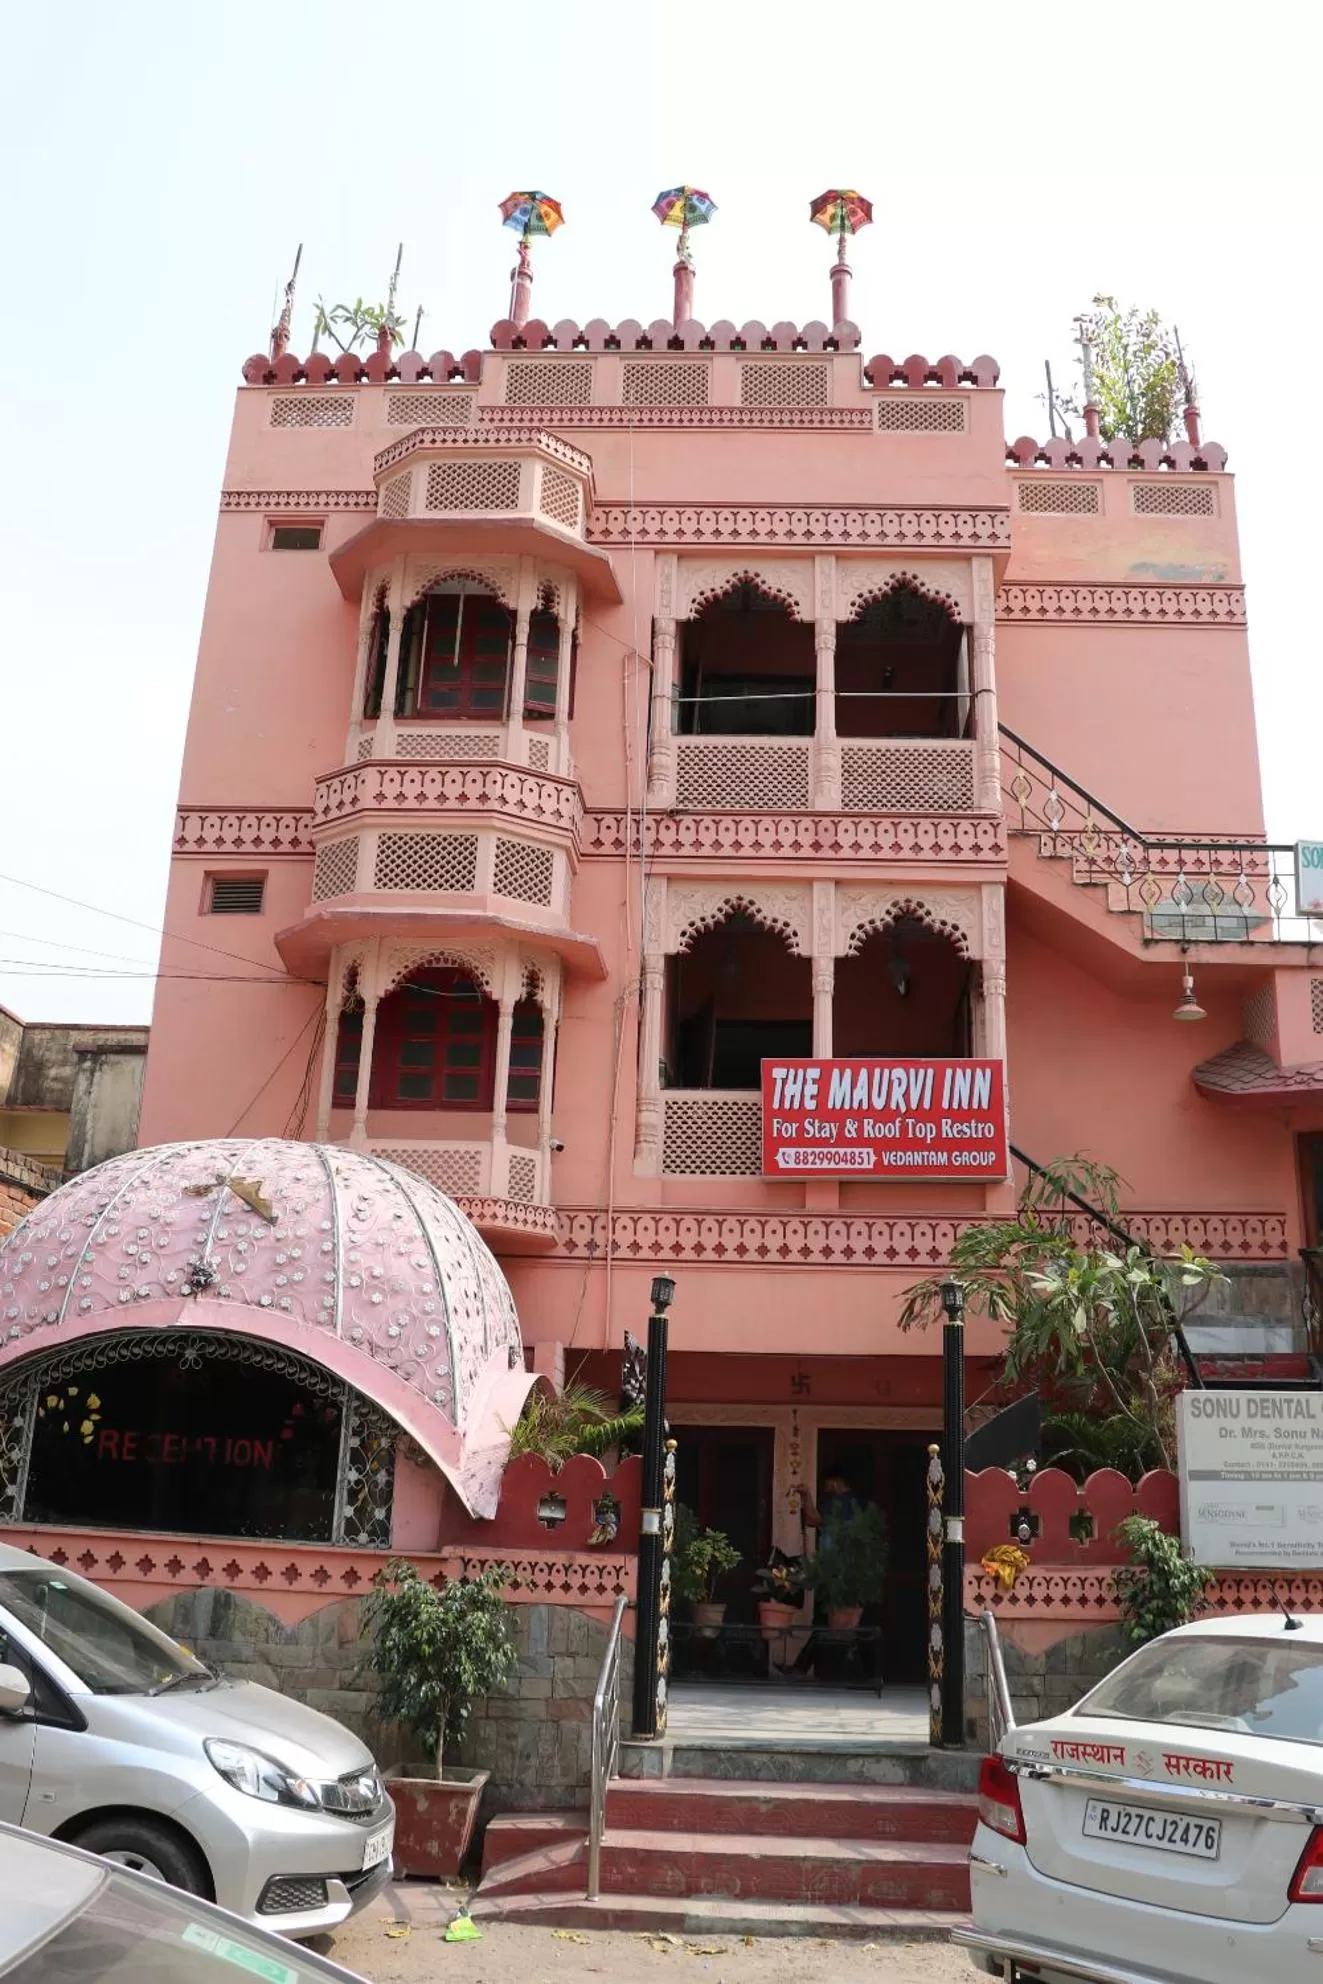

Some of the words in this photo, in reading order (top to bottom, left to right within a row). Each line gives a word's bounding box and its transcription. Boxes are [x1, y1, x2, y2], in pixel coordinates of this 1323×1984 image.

[771, 1067, 821, 1111] THE
[827, 1067, 935, 1113] MAURVI
[941, 1067, 993, 1111] INN
[772, 1118, 799, 1138] For
[803, 1118, 839, 1143] Stay
[844, 1117, 858, 1138] &
[863, 1117, 902, 1138] Roof
[905, 1119, 936, 1143] Top
[941, 1118, 995, 1139] Restro
[793, 1150, 872, 1166] 8829904851
[881, 1150, 948, 1167] VEDANTAM
[951, 1150, 996, 1167] GROUP
[1190, 1397, 1241, 1419] SONU
[1247, 1398, 1317, 1420] DENTAL
[1218, 1427, 1238, 1439] Dr.
[1241, 1427, 1271, 1439] Mrs.
[1274, 1427, 1308, 1440] Sonu
[1050, 1739, 1126, 1767] राजस्थान
[1162, 1752, 1234, 1783] सरकार
[1098, 1807, 1217, 1850] RJ27CJ2476
